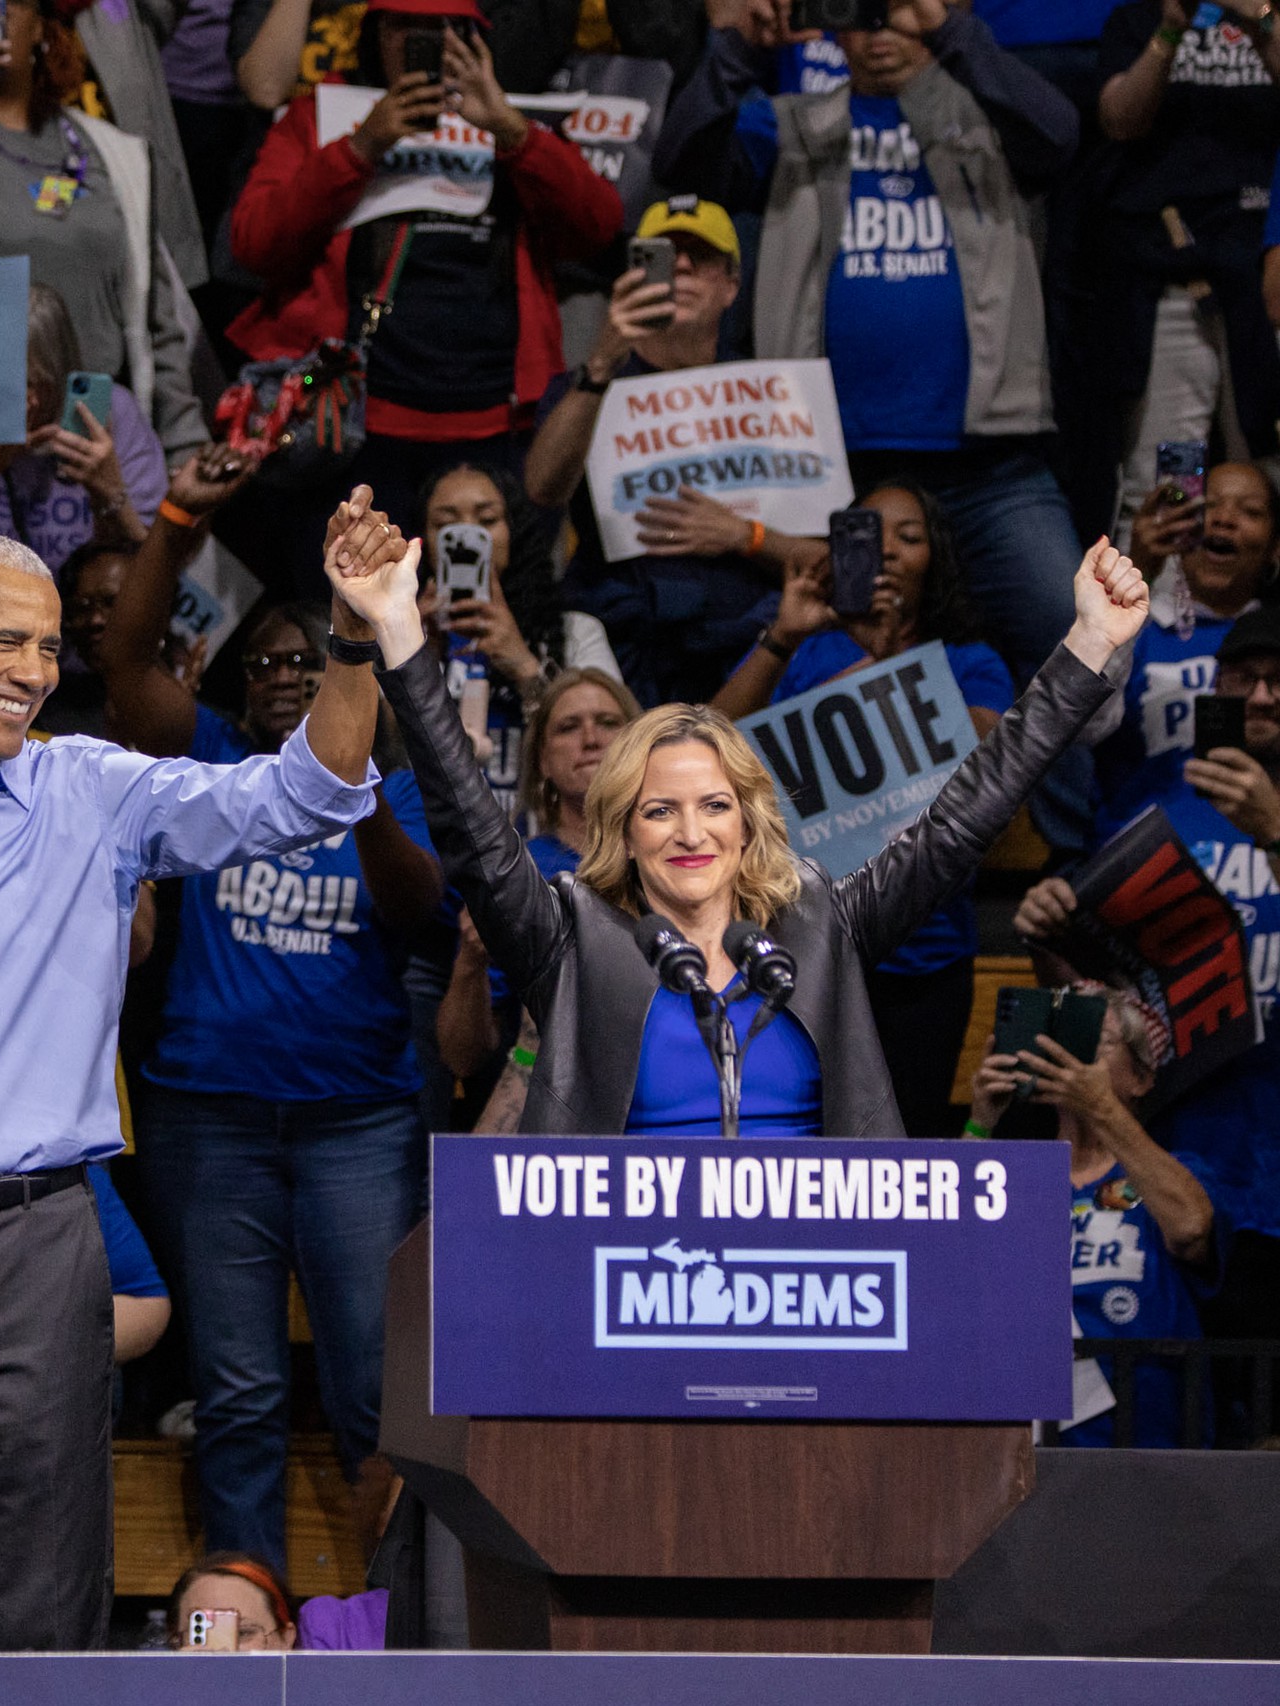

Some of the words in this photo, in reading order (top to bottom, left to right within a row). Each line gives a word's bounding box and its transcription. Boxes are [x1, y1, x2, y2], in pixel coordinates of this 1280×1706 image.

[841, 196, 953, 252] ABDU
[882, 250, 949, 276] SENATE
[626, 375, 790, 419] MOVING
[613, 411, 815, 459] MICHIGAN
[622, 451, 824, 501] FORWARD
[752, 661, 958, 820] VOTE
[800, 820, 834, 849] BY
[215, 860, 360, 934] ABDUL
[265, 923, 333, 956] SENATE
[1098, 841, 1249, 1059] VOTE
[494, 1155, 611, 1217] VOTE
[625, 1157, 686, 1217] BY
[701, 1157, 960, 1220] NOVEMBER
[974, 1159, 1008, 1222] 3
